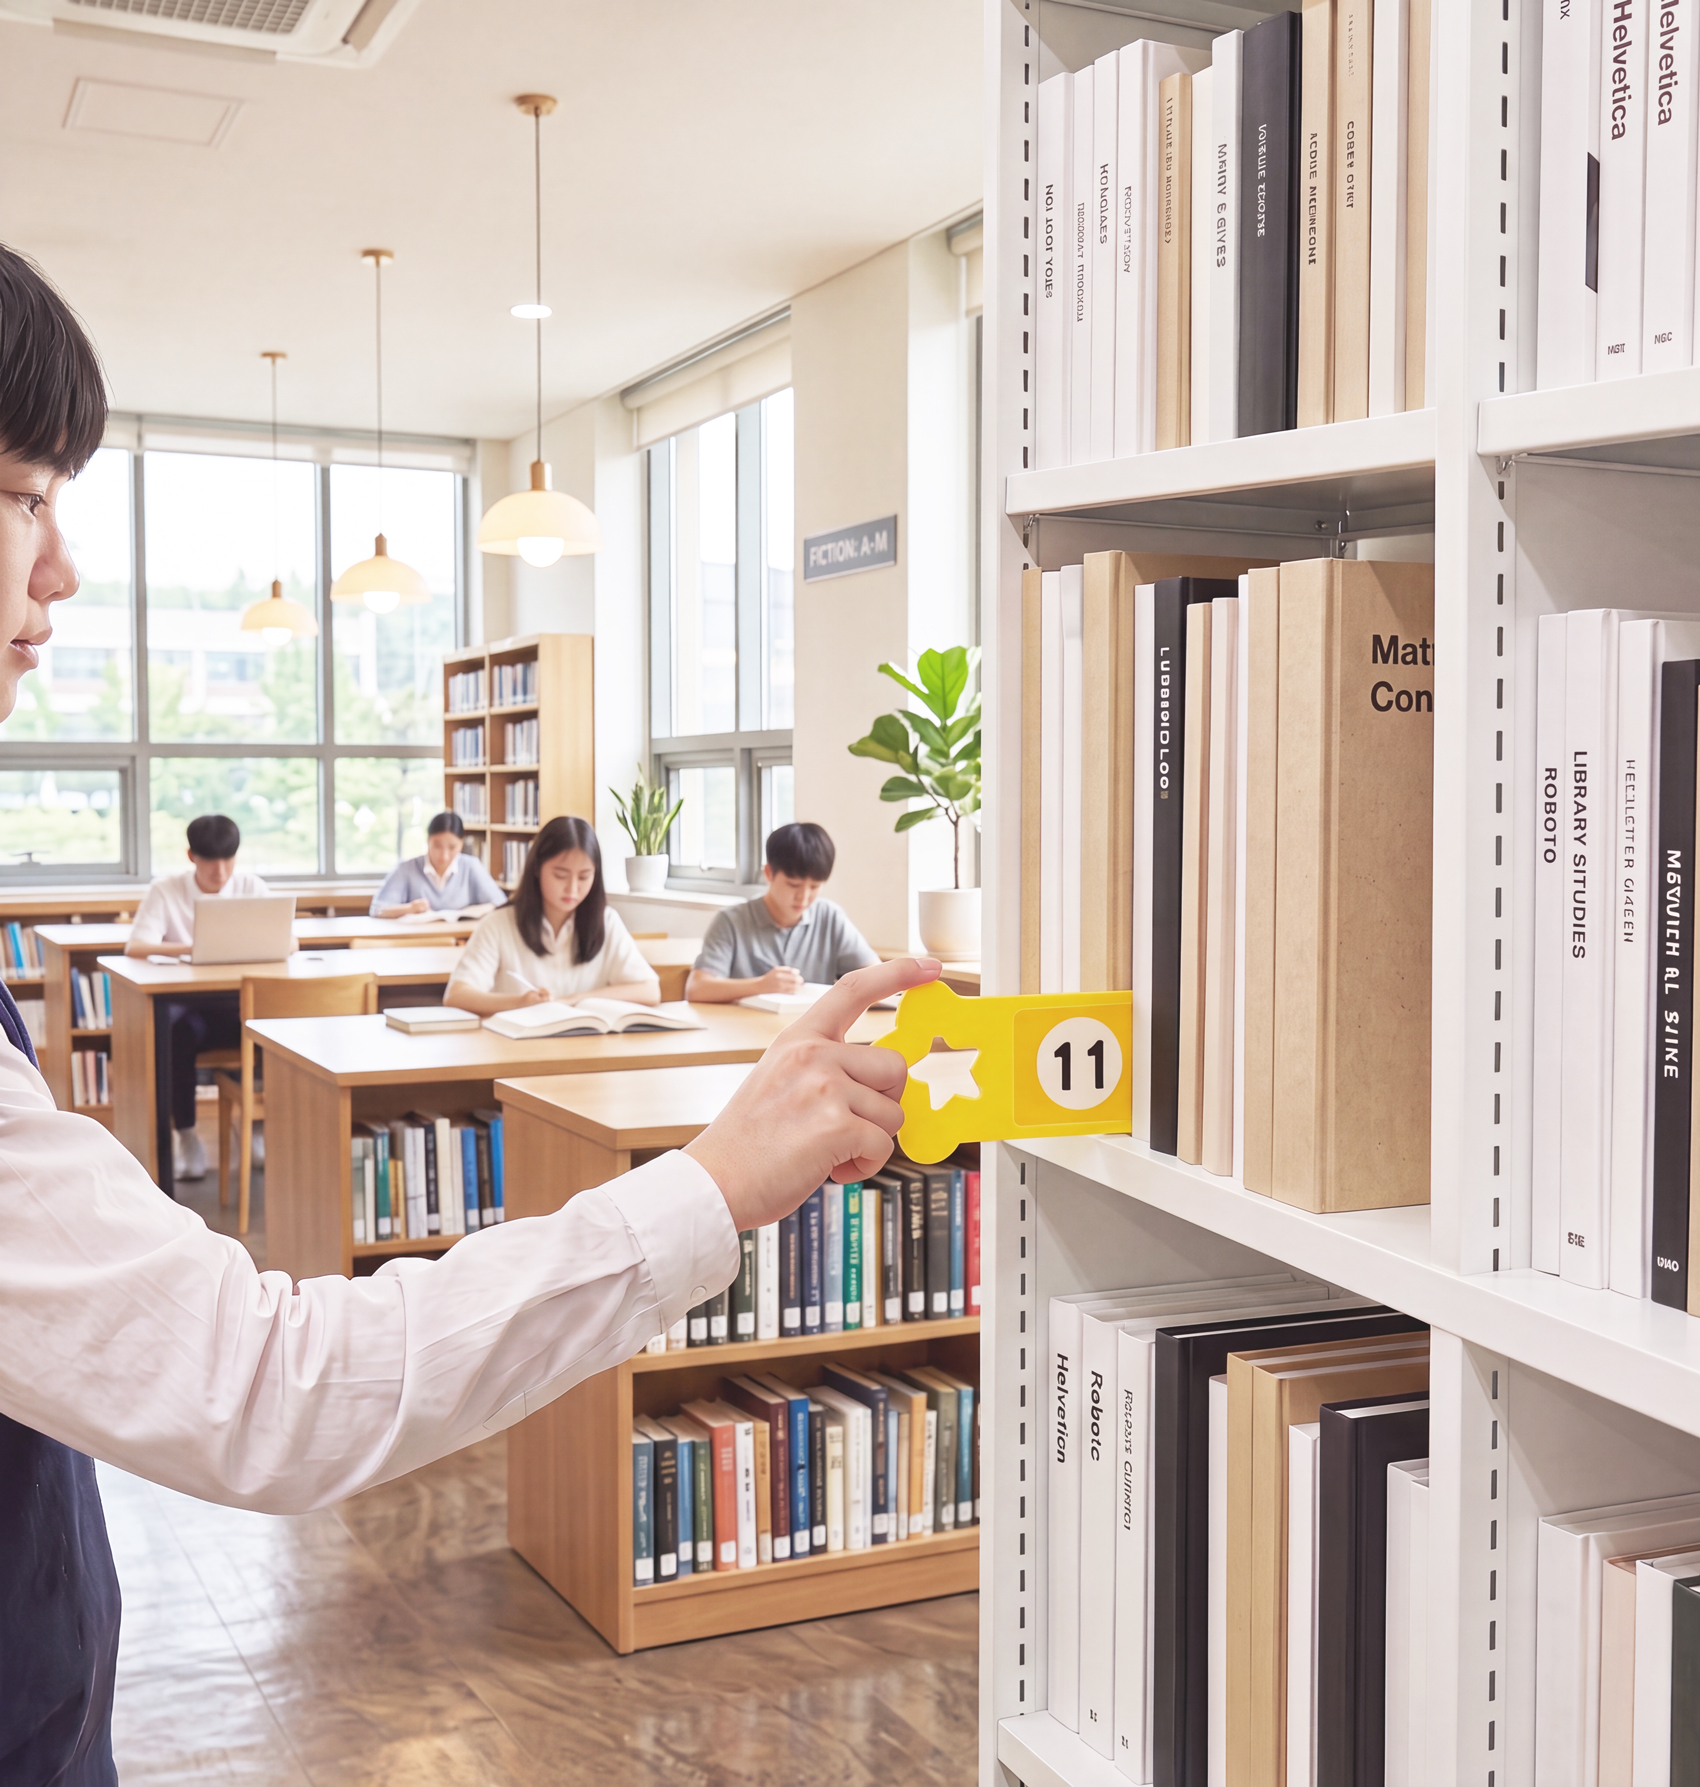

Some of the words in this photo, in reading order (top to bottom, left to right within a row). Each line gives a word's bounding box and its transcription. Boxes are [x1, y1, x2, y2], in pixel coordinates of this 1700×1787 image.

[1611, 0, 1633, 141] Helvetica
[1370, 680, 1434, 713] Con
[1371, 634, 1434, 666] Mat
[1543, 767, 1558, 864] ROBOTO
[1573, 751, 1588, 846] LIBRARY
[1572, 853, 1587, 959] SITUDIES
[1053, 1039, 1105, 1091] 11
